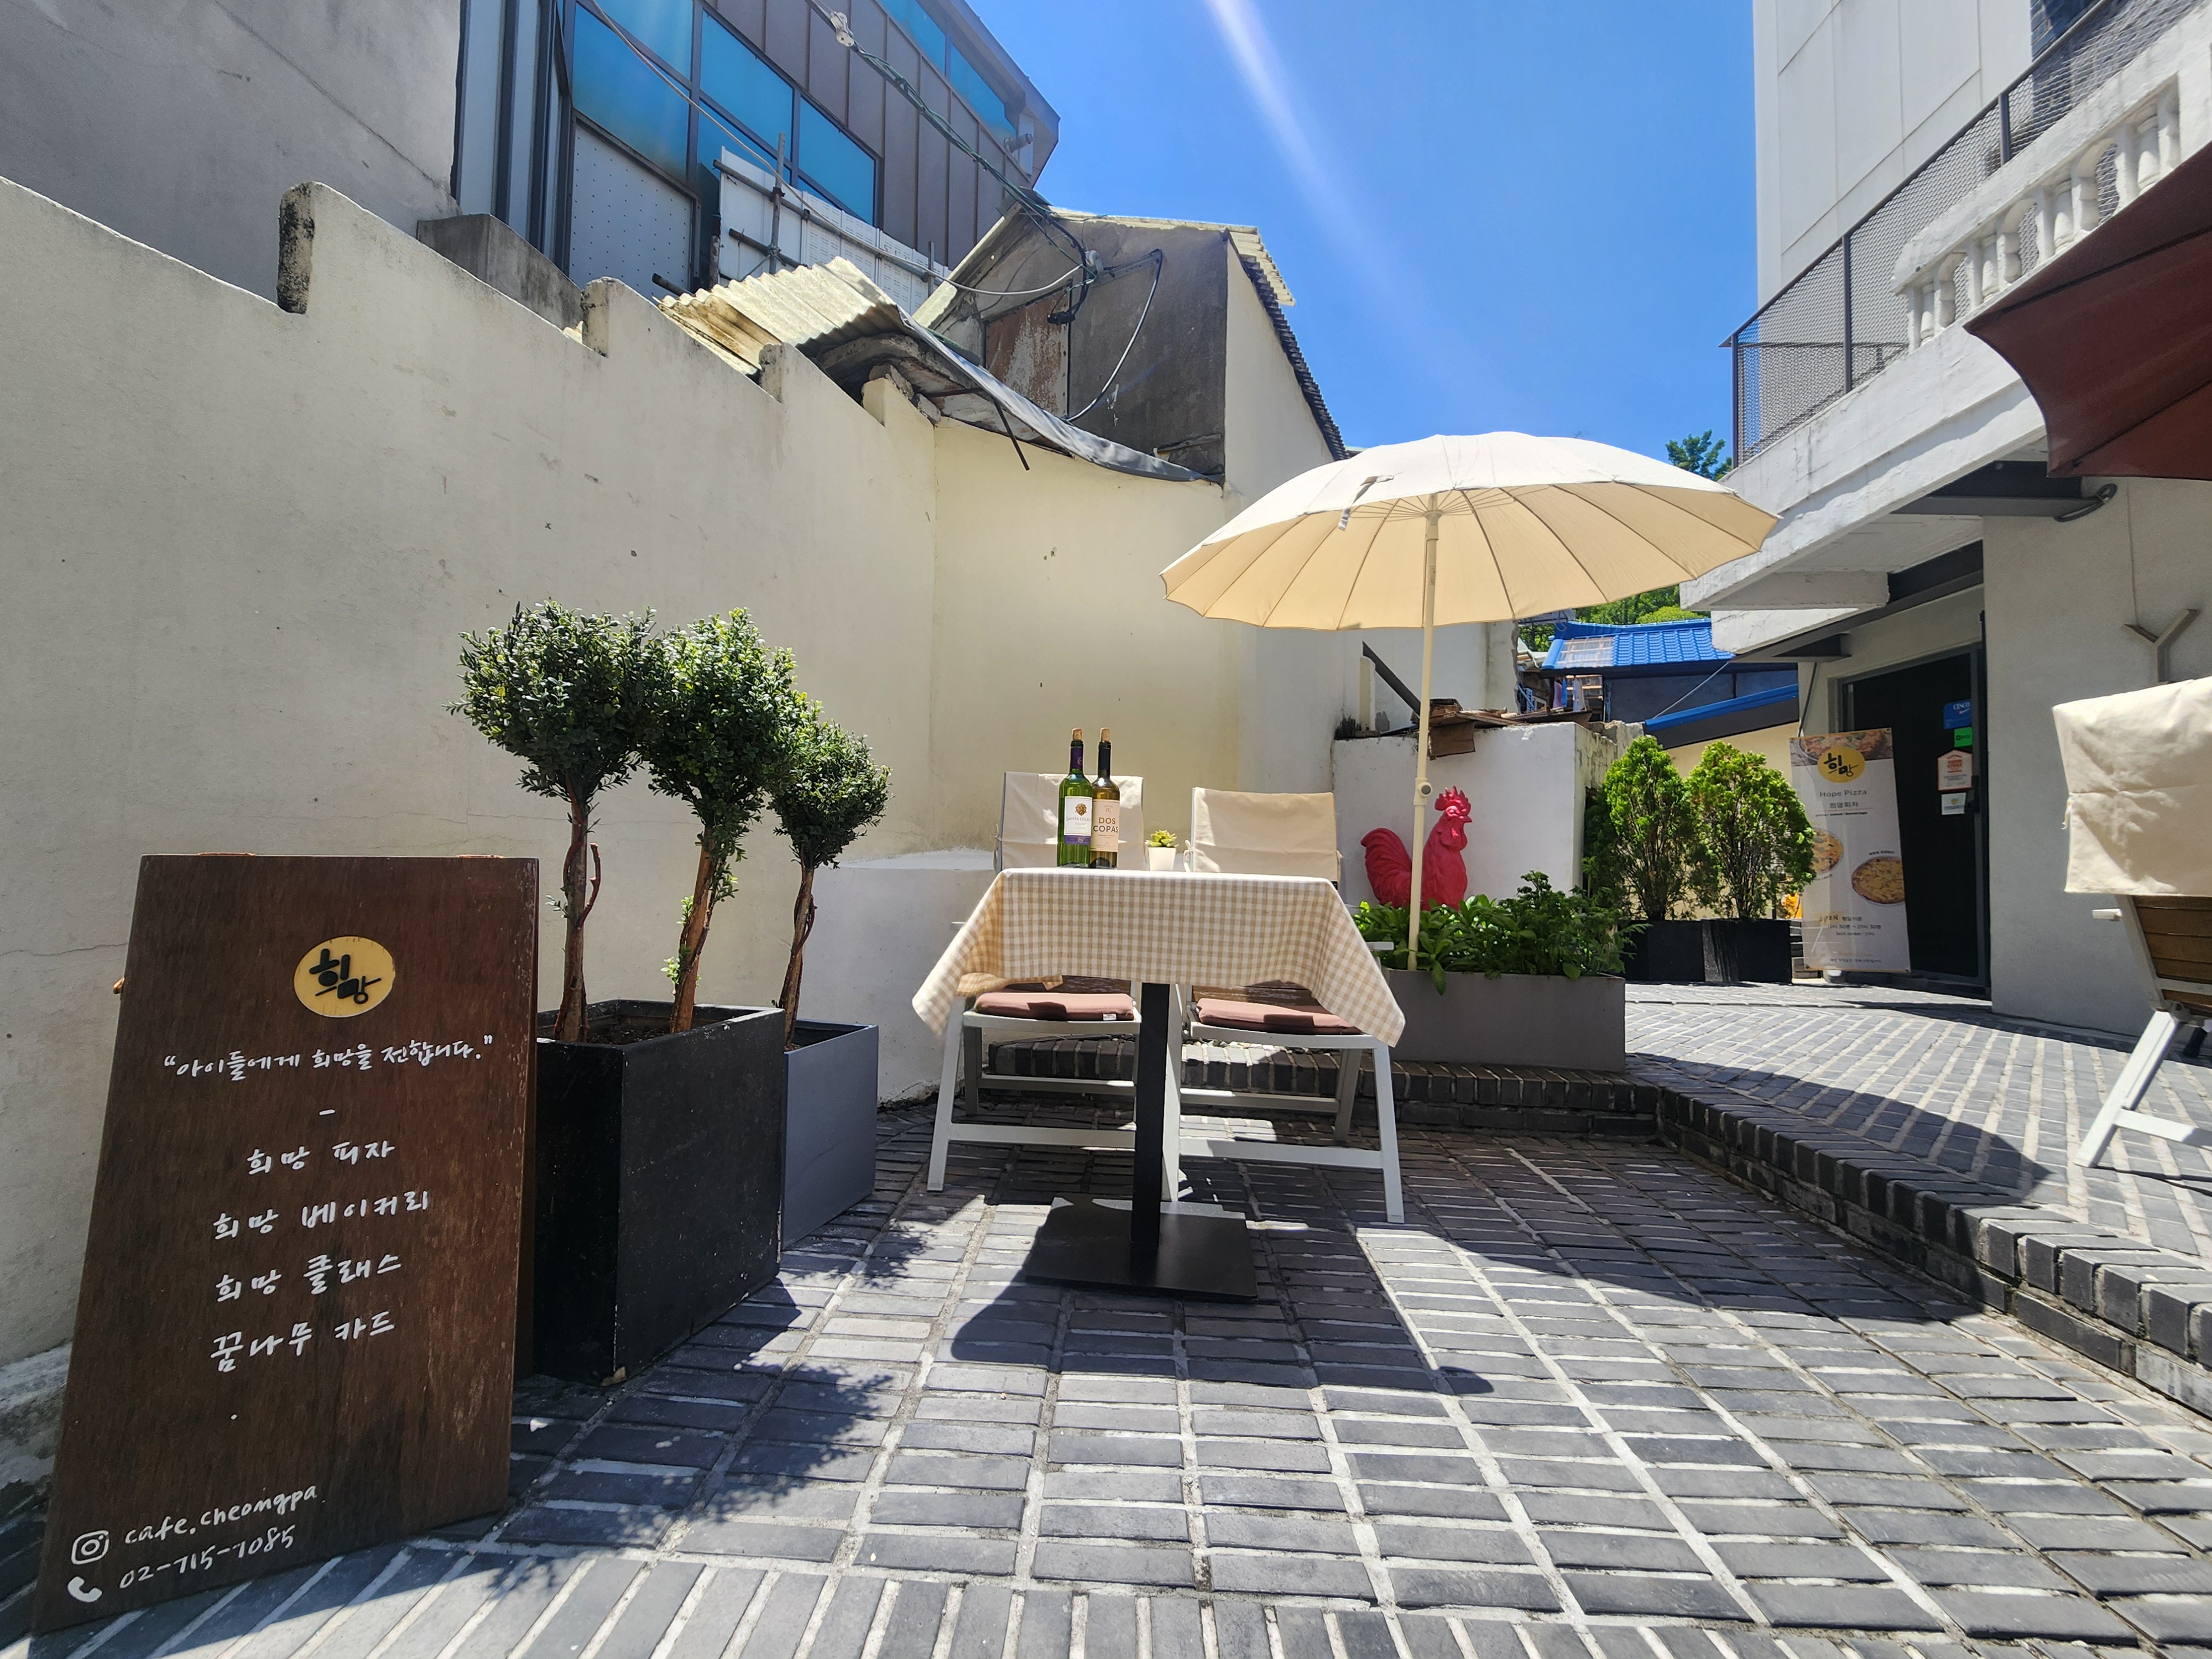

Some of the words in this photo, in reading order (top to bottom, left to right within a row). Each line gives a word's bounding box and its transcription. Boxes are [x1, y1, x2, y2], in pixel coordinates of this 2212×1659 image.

[1823, 753, 1859, 777] 희망
[1093, 825, 1119, 833] COPAS
[309, 948, 382, 1004] 희망
[311, 1043, 373, 1070] 희망을
[247, 1146, 310, 1175] 희망
[332, 1140, 395, 1165] 피자
[213, 1209, 279, 1240] 희망
[301, 1190, 429, 1228] 베이커리
[216, 1269, 282, 1302] 희망
[303, 1254, 401, 1295] 클래스
[210, 1322, 312, 1373] 꿈나무
[335, 1311, 395, 1340] 카드
[119, 1525, 296, 1590] 02-715-7085
